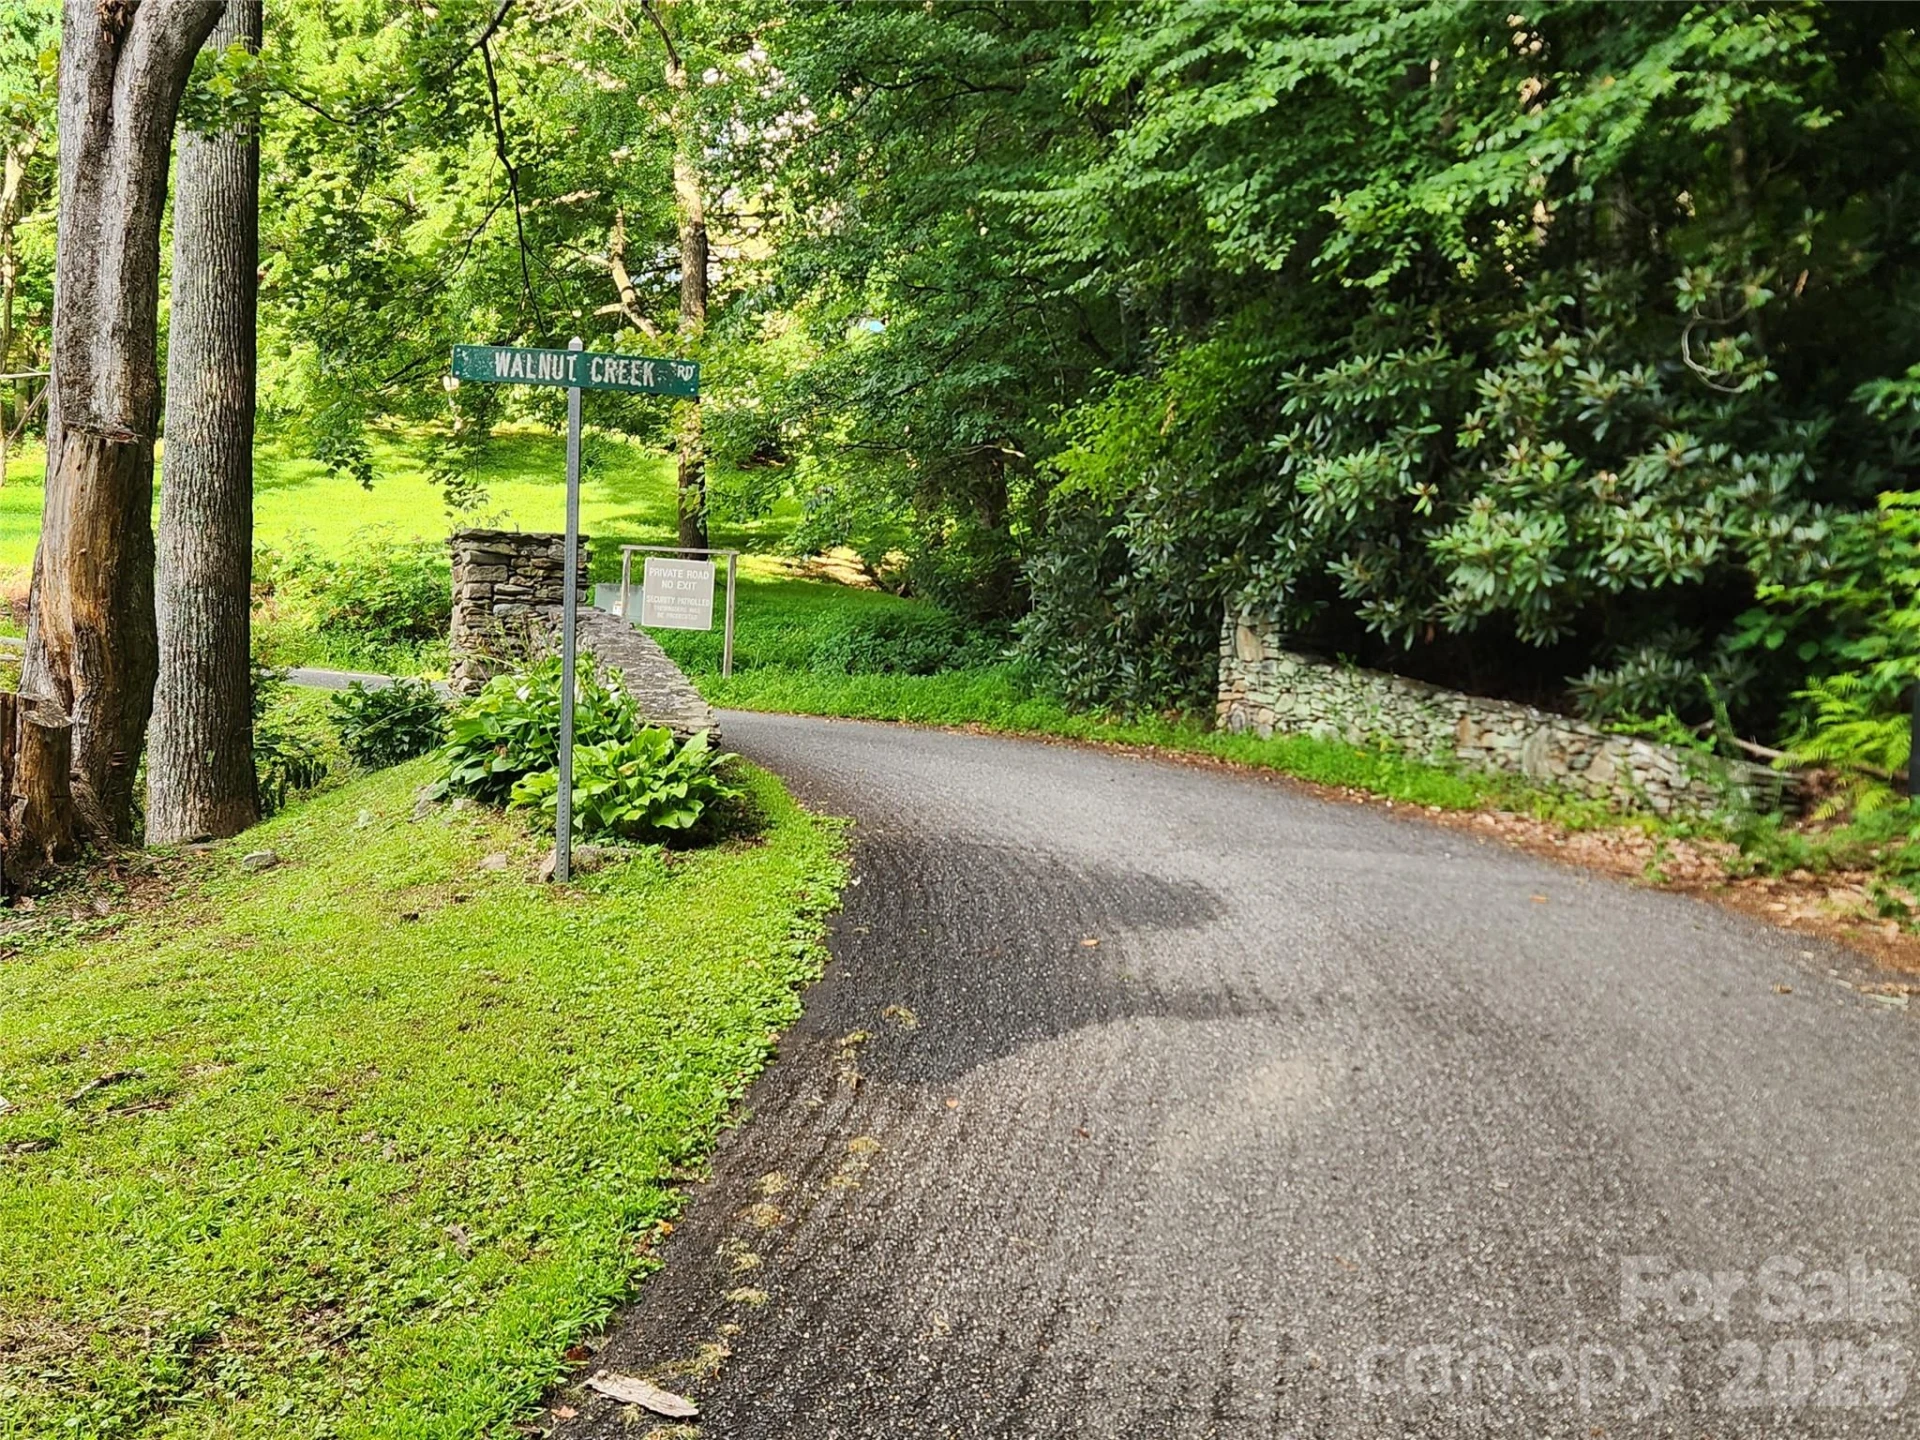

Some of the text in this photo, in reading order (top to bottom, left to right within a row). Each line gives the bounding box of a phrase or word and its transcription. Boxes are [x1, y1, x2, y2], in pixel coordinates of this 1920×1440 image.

[494, 351, 696, 387] WALNUT CREEK RD
[649, 568, 709, 579] PRIVATE ROAD
[661, 580, 697, 590] NO EXIT
